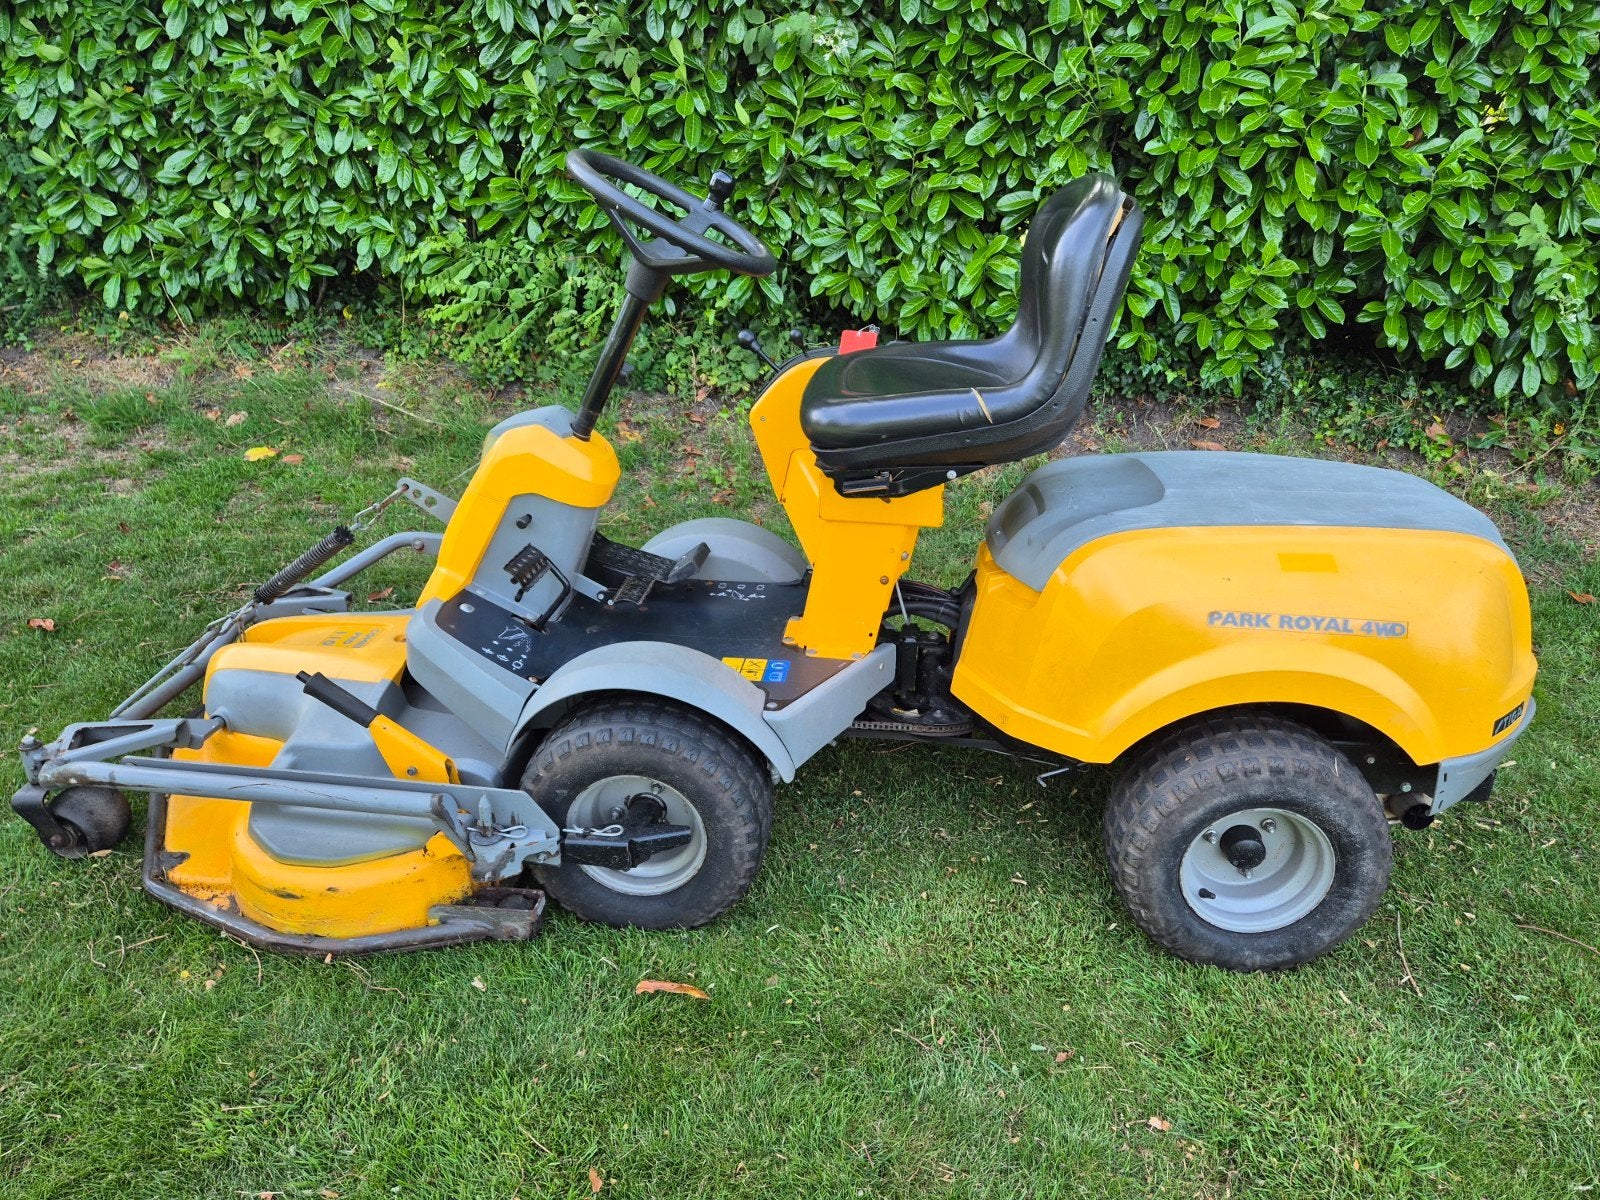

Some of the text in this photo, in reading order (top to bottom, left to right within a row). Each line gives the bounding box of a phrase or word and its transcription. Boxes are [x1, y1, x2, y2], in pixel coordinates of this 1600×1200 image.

[1208, 610, 1407, 637] PARK ROYAL 4WD
